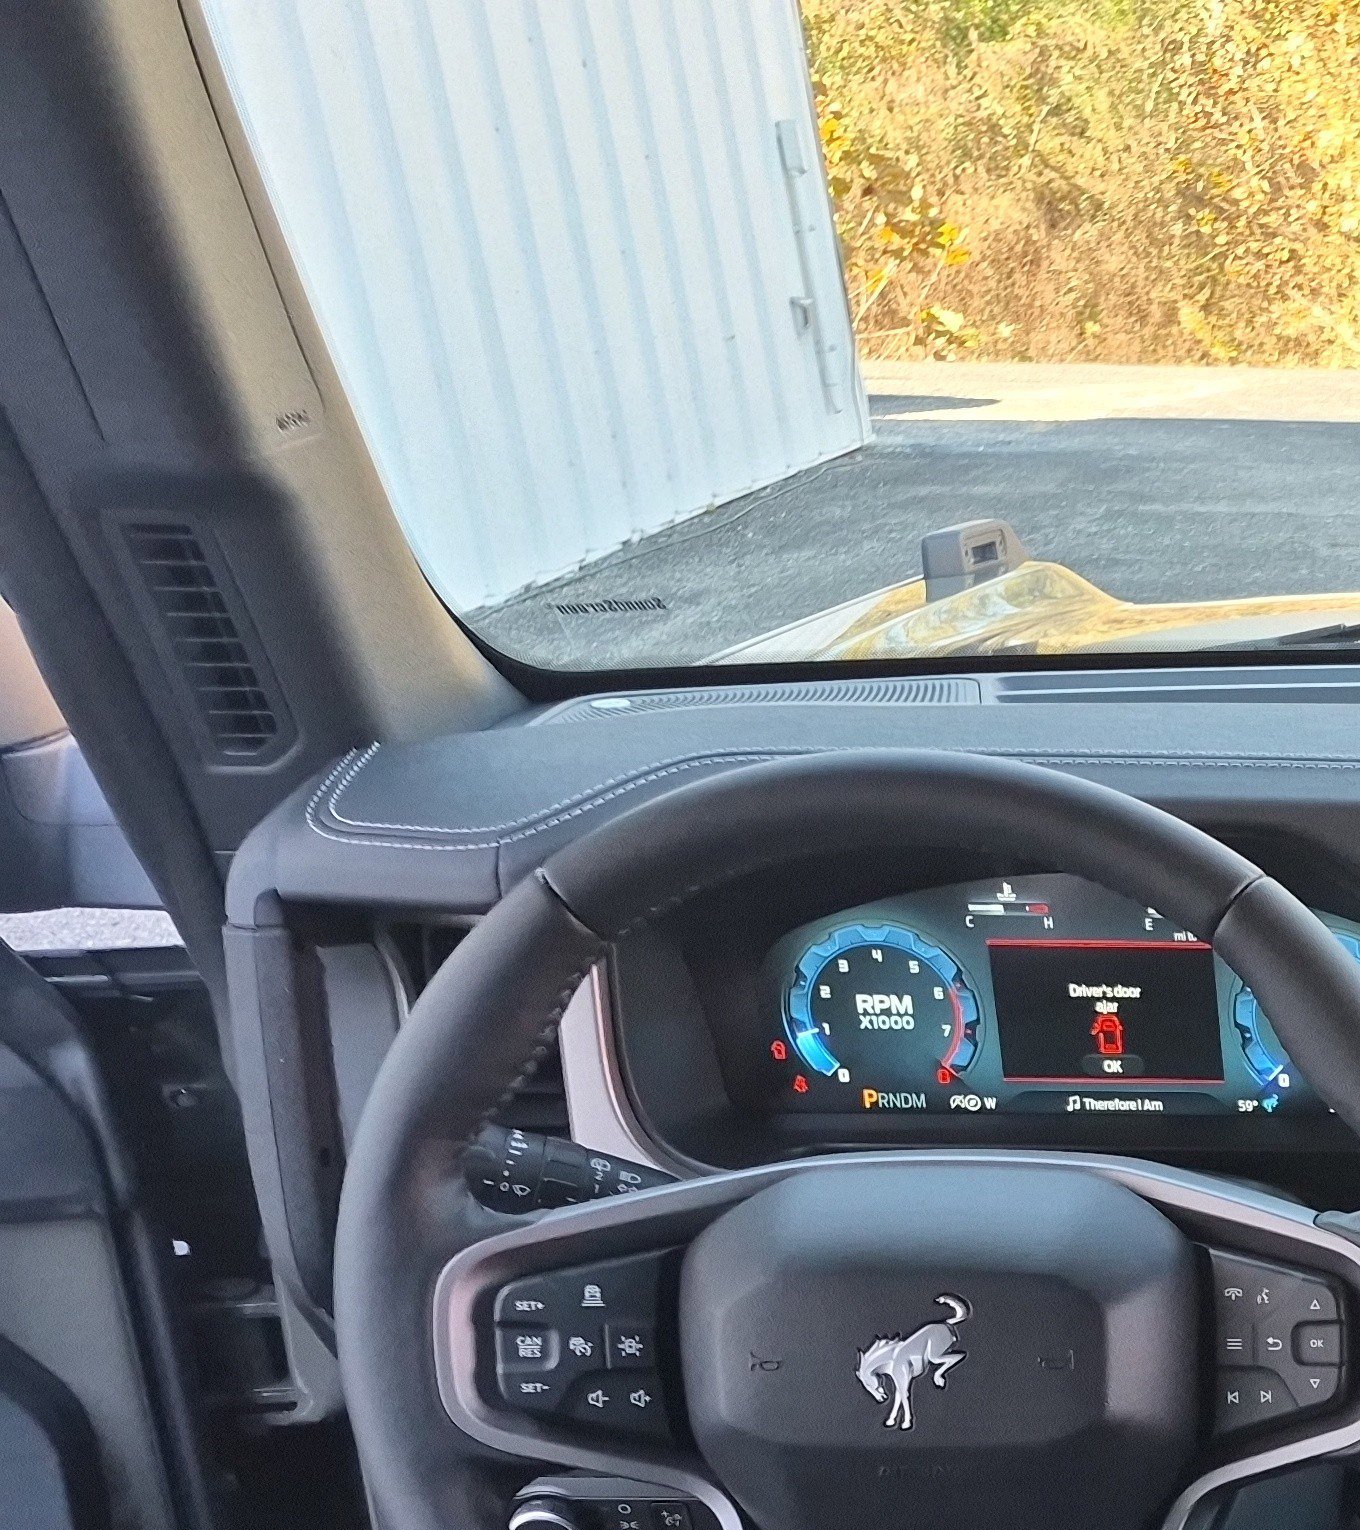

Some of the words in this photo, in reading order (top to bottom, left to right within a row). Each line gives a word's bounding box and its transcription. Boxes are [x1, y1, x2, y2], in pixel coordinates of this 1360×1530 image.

[965, 916, 975, 928] C
[1044, 917, 1054, 929] H
[1144, 918, 1153, 930] E
[871, 949, 883, 963] 4
[837, 959, 849, 973] 3
[908, 960, 920, 974] 5
[819, 985, 831, 999] 2
[933, 986, 945, 1000] 6
[1068, 983, 1114, 998] Driver's
[1113, 984, 1141, 998] door
[855, 994, 914, 1015] RPM
[1095, 1000, 1119, 1014] ajar
[822, 1022, 831, 1035] 1
[859, 1015, 915, 1030] X1000
[941, 1024, 951, 1038] 7
[1103, 1060, 1123, 1074] OK
[837, 1068, 851, 1083] 0
[1083, 1098, 1138, 1111] Therefore
[1143, 1098, 1163, 1111] Am
[516, 1336, 543, 1345] CAN
[1309, 1339, 1324, 1348] OK
[518, 1348, 542, 1358] RES
